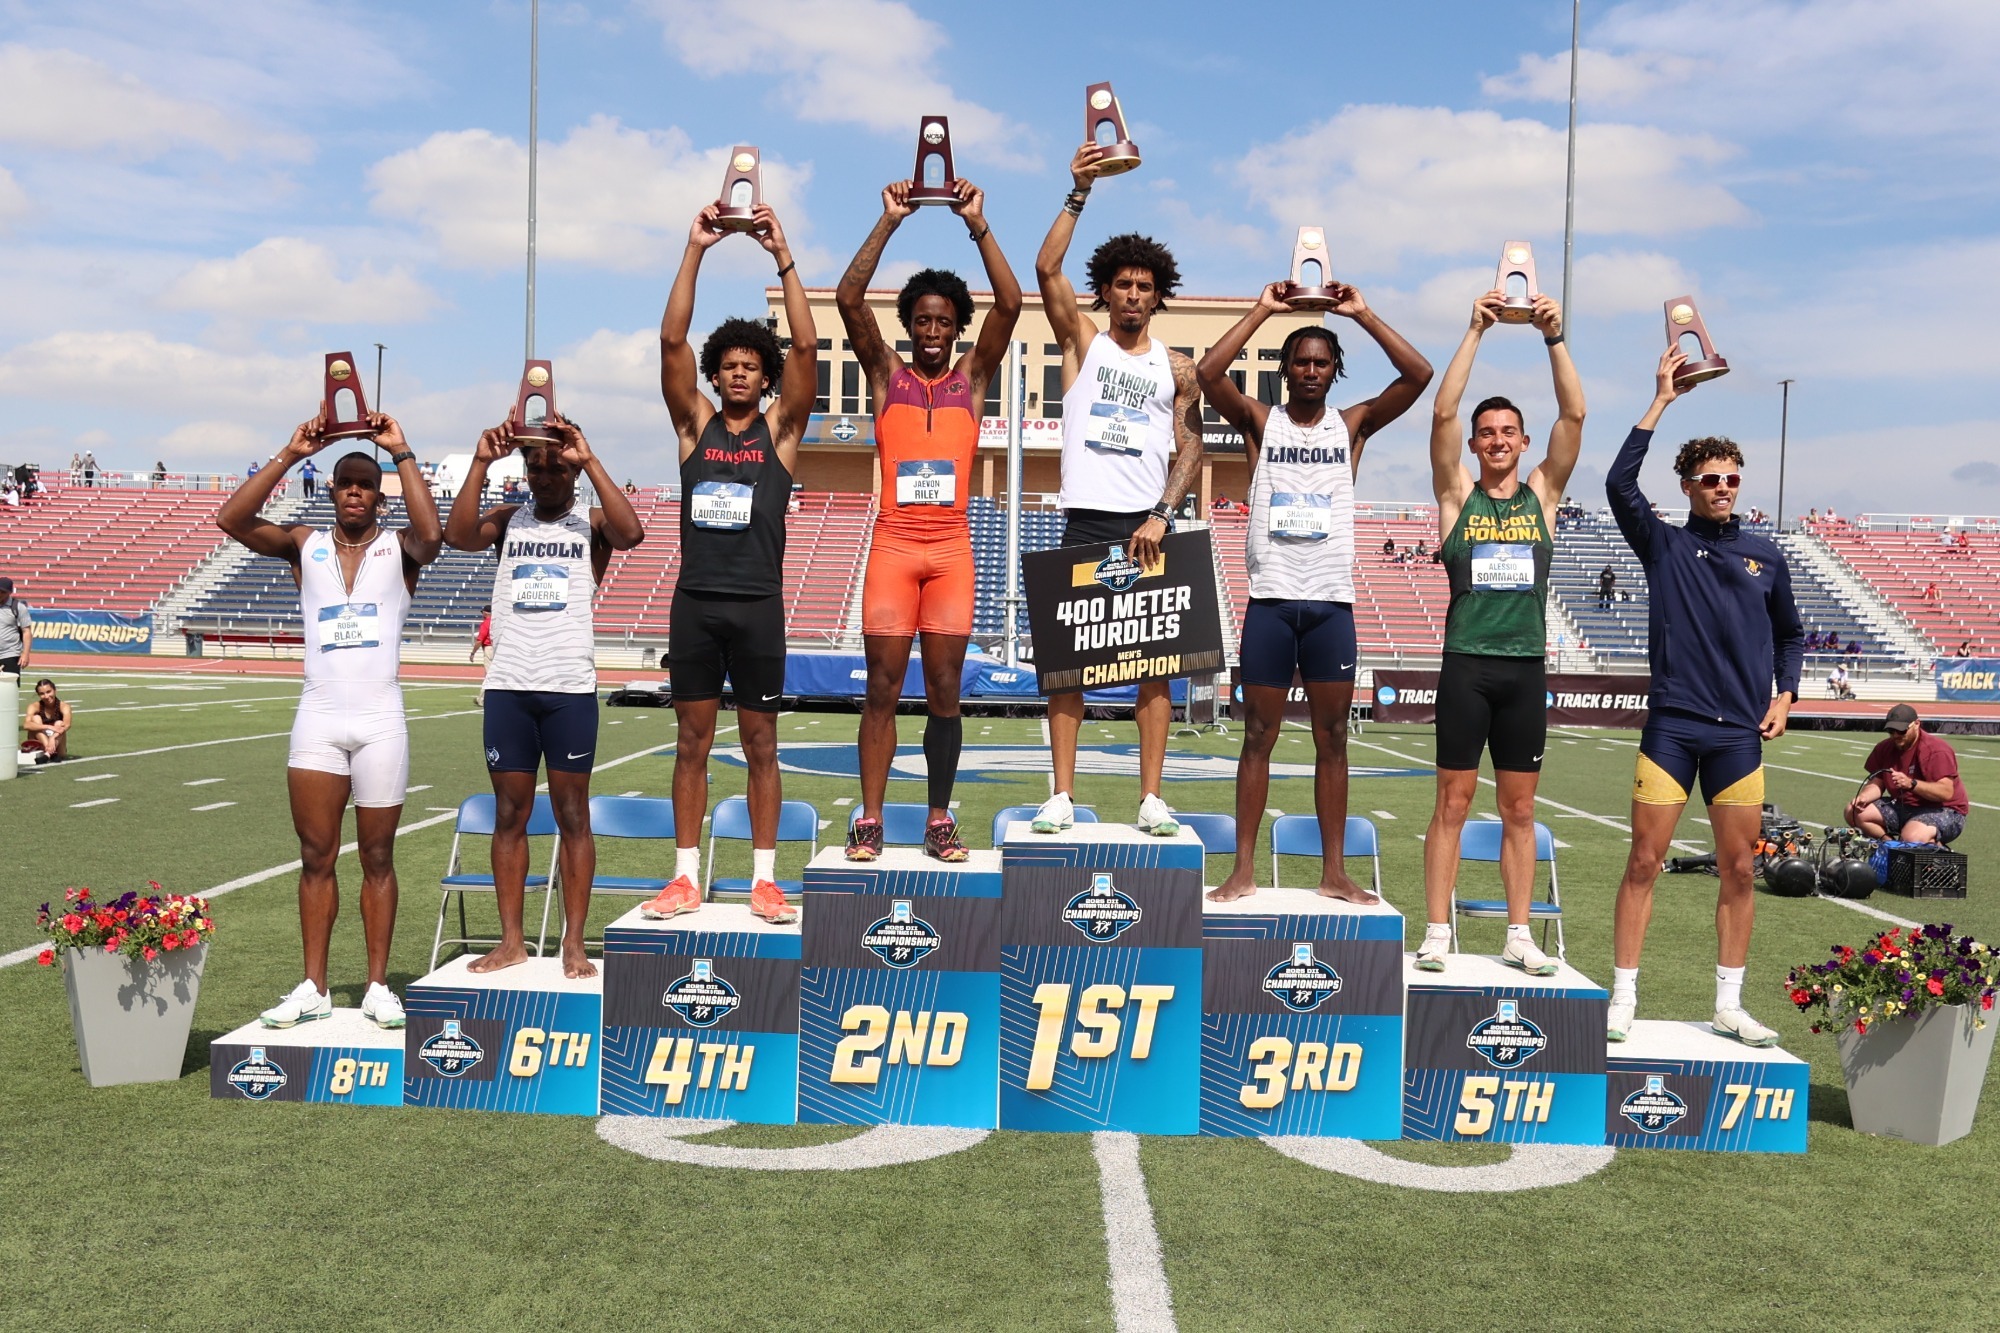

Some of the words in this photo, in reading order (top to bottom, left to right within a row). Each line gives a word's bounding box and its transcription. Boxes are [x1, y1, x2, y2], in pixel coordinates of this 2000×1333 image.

[1097, 365, 1158, 398] OKLAHOMA
[1101, 383, 1147, 409] BAPTIST
[1108, 422, 1127, 432] SEAN
[1101, 431, 1129, 445] DIXON
[1225, 433, 1233, 444] &
[704, 448, 733, 462] STAN
[734, 449, 765, 465] STATE
[1267, 447, 1346, 464] LINCOLN
[913, 480, 940, 488] JAEVON
[914, 489, 939, 500] RILEY
[711, 500, 732, 509] TRENT
[693, 509, 748, 521] LAUDERDALE
[1277, 519, 1323, 531] HAMILTON
[1468, 514, 1497, 527] CAL
[1501, 514, 1537, 530] POLY
[1463, 527, 1542, 542] POMONA
[507, 541, 585, 560] LINCOLN
[1488, 562, 1517, 571] ALESSIO
[1476, 572, 1530, 582] SOMMACAL
[524, 582, 553, 590] CLINTON
[516, 590, 560, 601] LAGUERRE
[1056, 597, 1106, 627] 400
[1112, 585, 1192, 620] METER
[337, 621, 358, 630] ROBIN
[334, 630, 363, 641] BLACK
[1074, 614, 1181, 652] HURDLES
[1117, 649, 1142, 661] MEN'S
[1083, 654, 1181, 686] CHAMPION
[991, 672, 1017, 683] GILL
[1941, 672, 1996, 690] TRACK
[1294, 687, 1305, 702] &
[1556, 693, 1601, 708] TRACK
[1601, 694, 1613, 709] &
[1065, 909, 1139, 920] CHAMPIONSHIPS
[864, 937, 938, 947] CHAMPIONSHIPS
[1265, 979, 1340, 989] CHAMPIONSHIPS
[665, 994, 738, 1006] CHAMPIONSHIPS
[1026, 983, 1175, 1090] 1ST
[1469, 1035, 1544, 1047] CHAMPIONSHIPS
[830, 1004, 968, 1084] 2ND
[421, 1049, 482, 1059] CHAMPIONSHIPS
[509, 1027, 591, 1077] 6TH
[330, 1058, 389, 1094] 8TH
[645, 1037, 755, 1104] 4TH
[1240, 1036, 1363, 1108] 3RD
[229, 1074, 286, 1084] CHAMPIONSHIPS
[1454, 1076, 1555, 1135] 5TH
[1622, 1104, 1685, 1115] CHAMPIONSHIPS
[1720, 1084, 1795, 1129] 7TH
